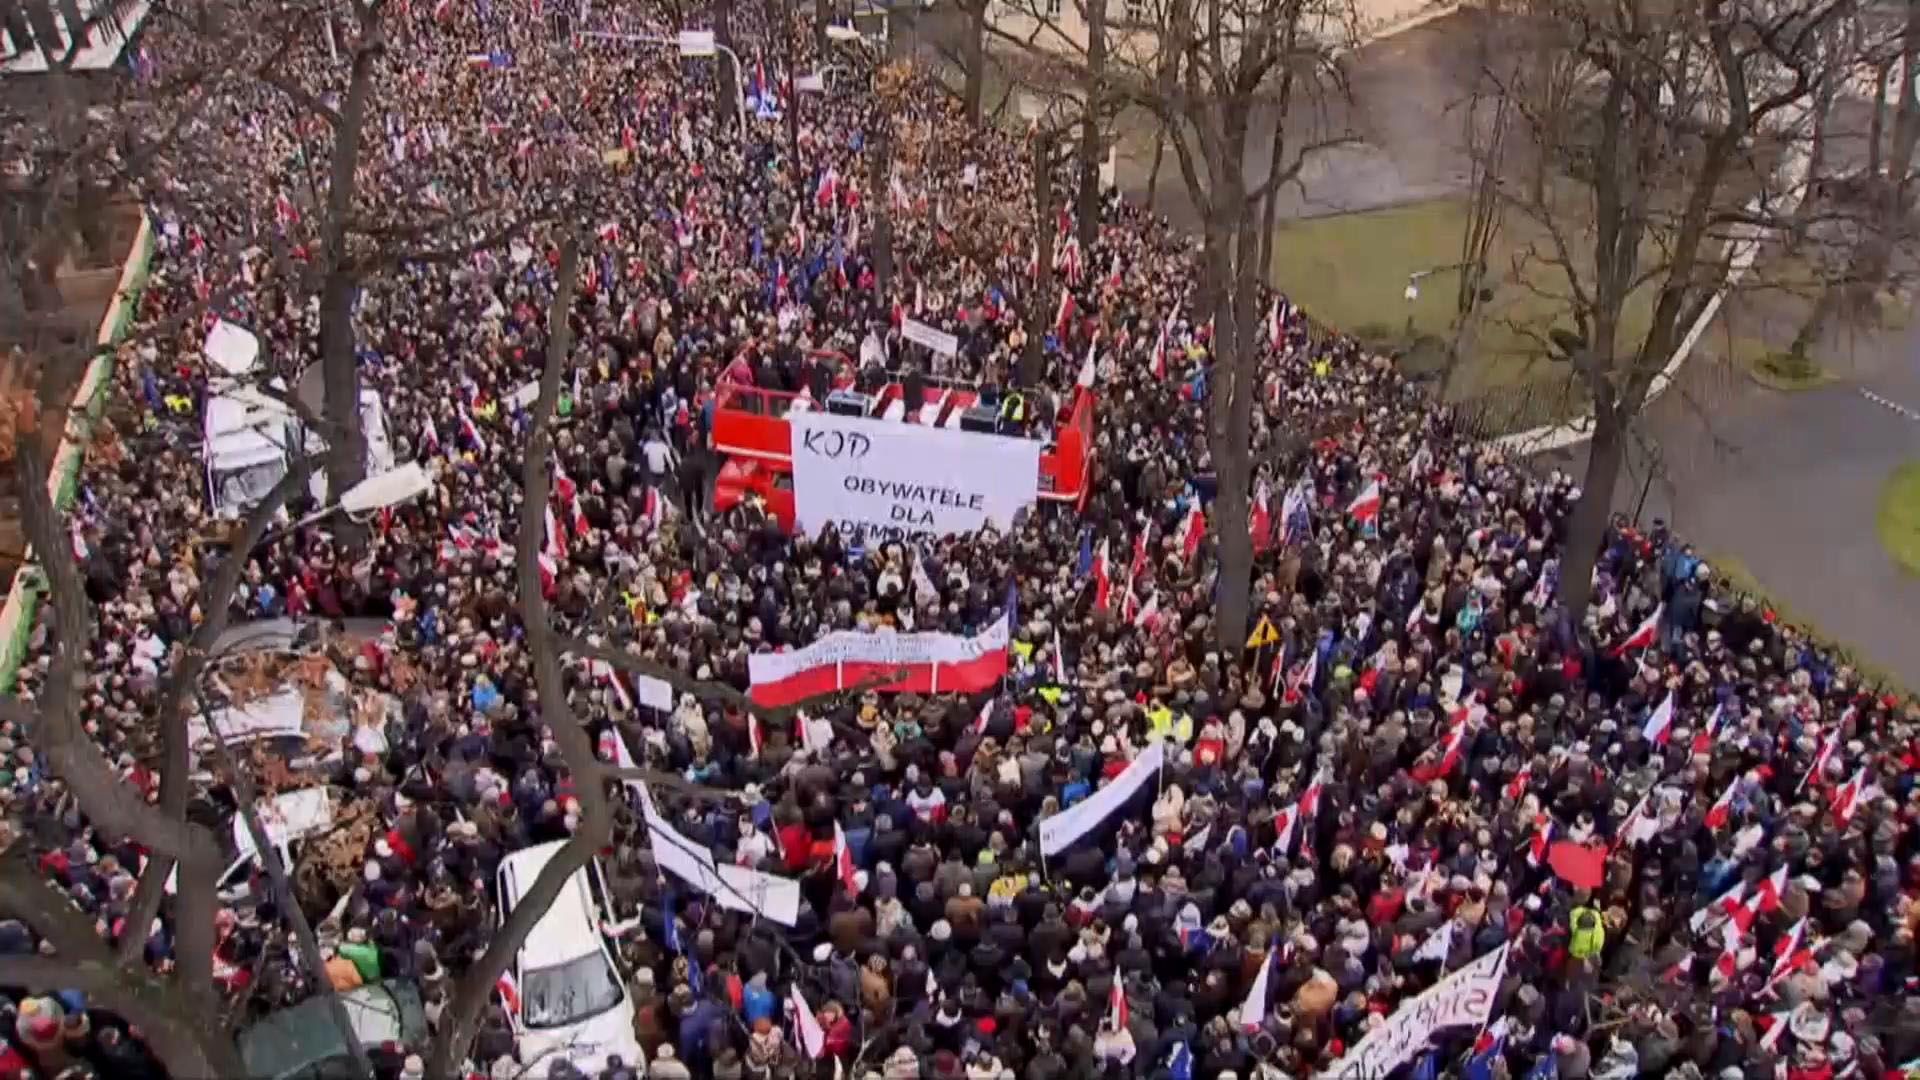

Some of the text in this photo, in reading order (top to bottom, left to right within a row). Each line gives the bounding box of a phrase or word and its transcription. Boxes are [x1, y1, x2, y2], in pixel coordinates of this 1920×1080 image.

[803, 427, 870, 459] KOD
[844, 475, 984, 512] OBYWATELE
[890, 503, 935, 526] DLA
